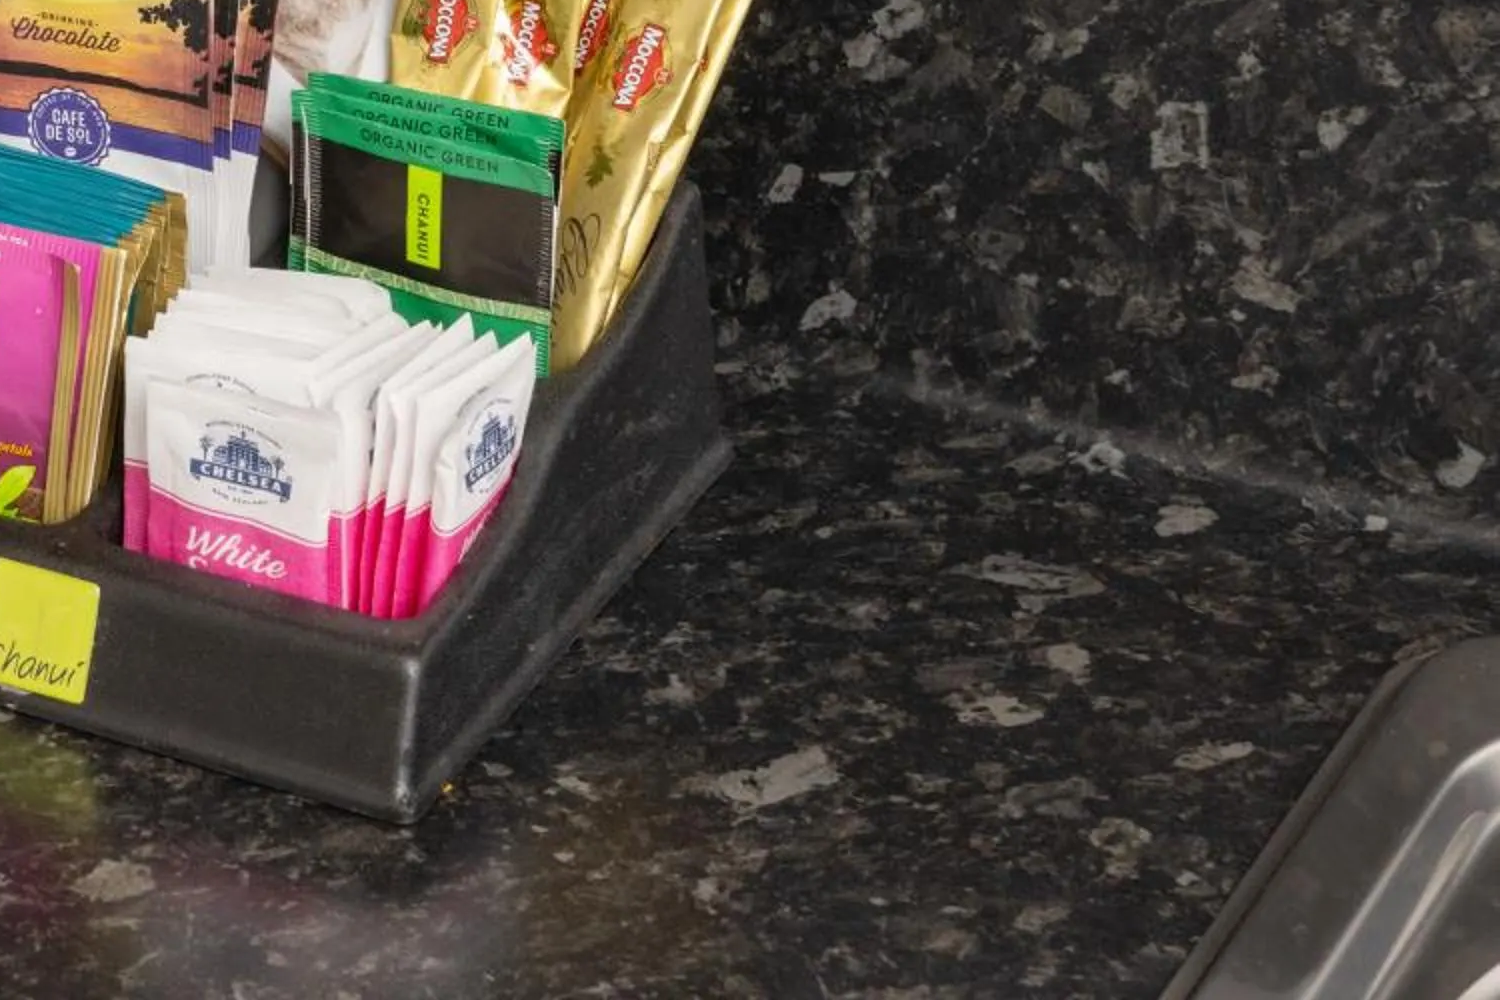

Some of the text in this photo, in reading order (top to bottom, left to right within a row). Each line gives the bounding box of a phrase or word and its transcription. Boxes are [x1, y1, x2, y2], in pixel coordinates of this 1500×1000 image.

[11, 16, 122, 53] Chocolate
[613, 26, 664, 106] MOCCONA
[45, 124, 94, 145] DE SOL
[51, 108, 87, 128] CAFE
[451, 107, 510, 130] GREEN
[359, 127, 500, 174] ORGANIC GREEN
[417, 193, 431, 261] CHANUI
[200, 463, 282, 492] CHELSEA
[185, 525, 289, 580] White
